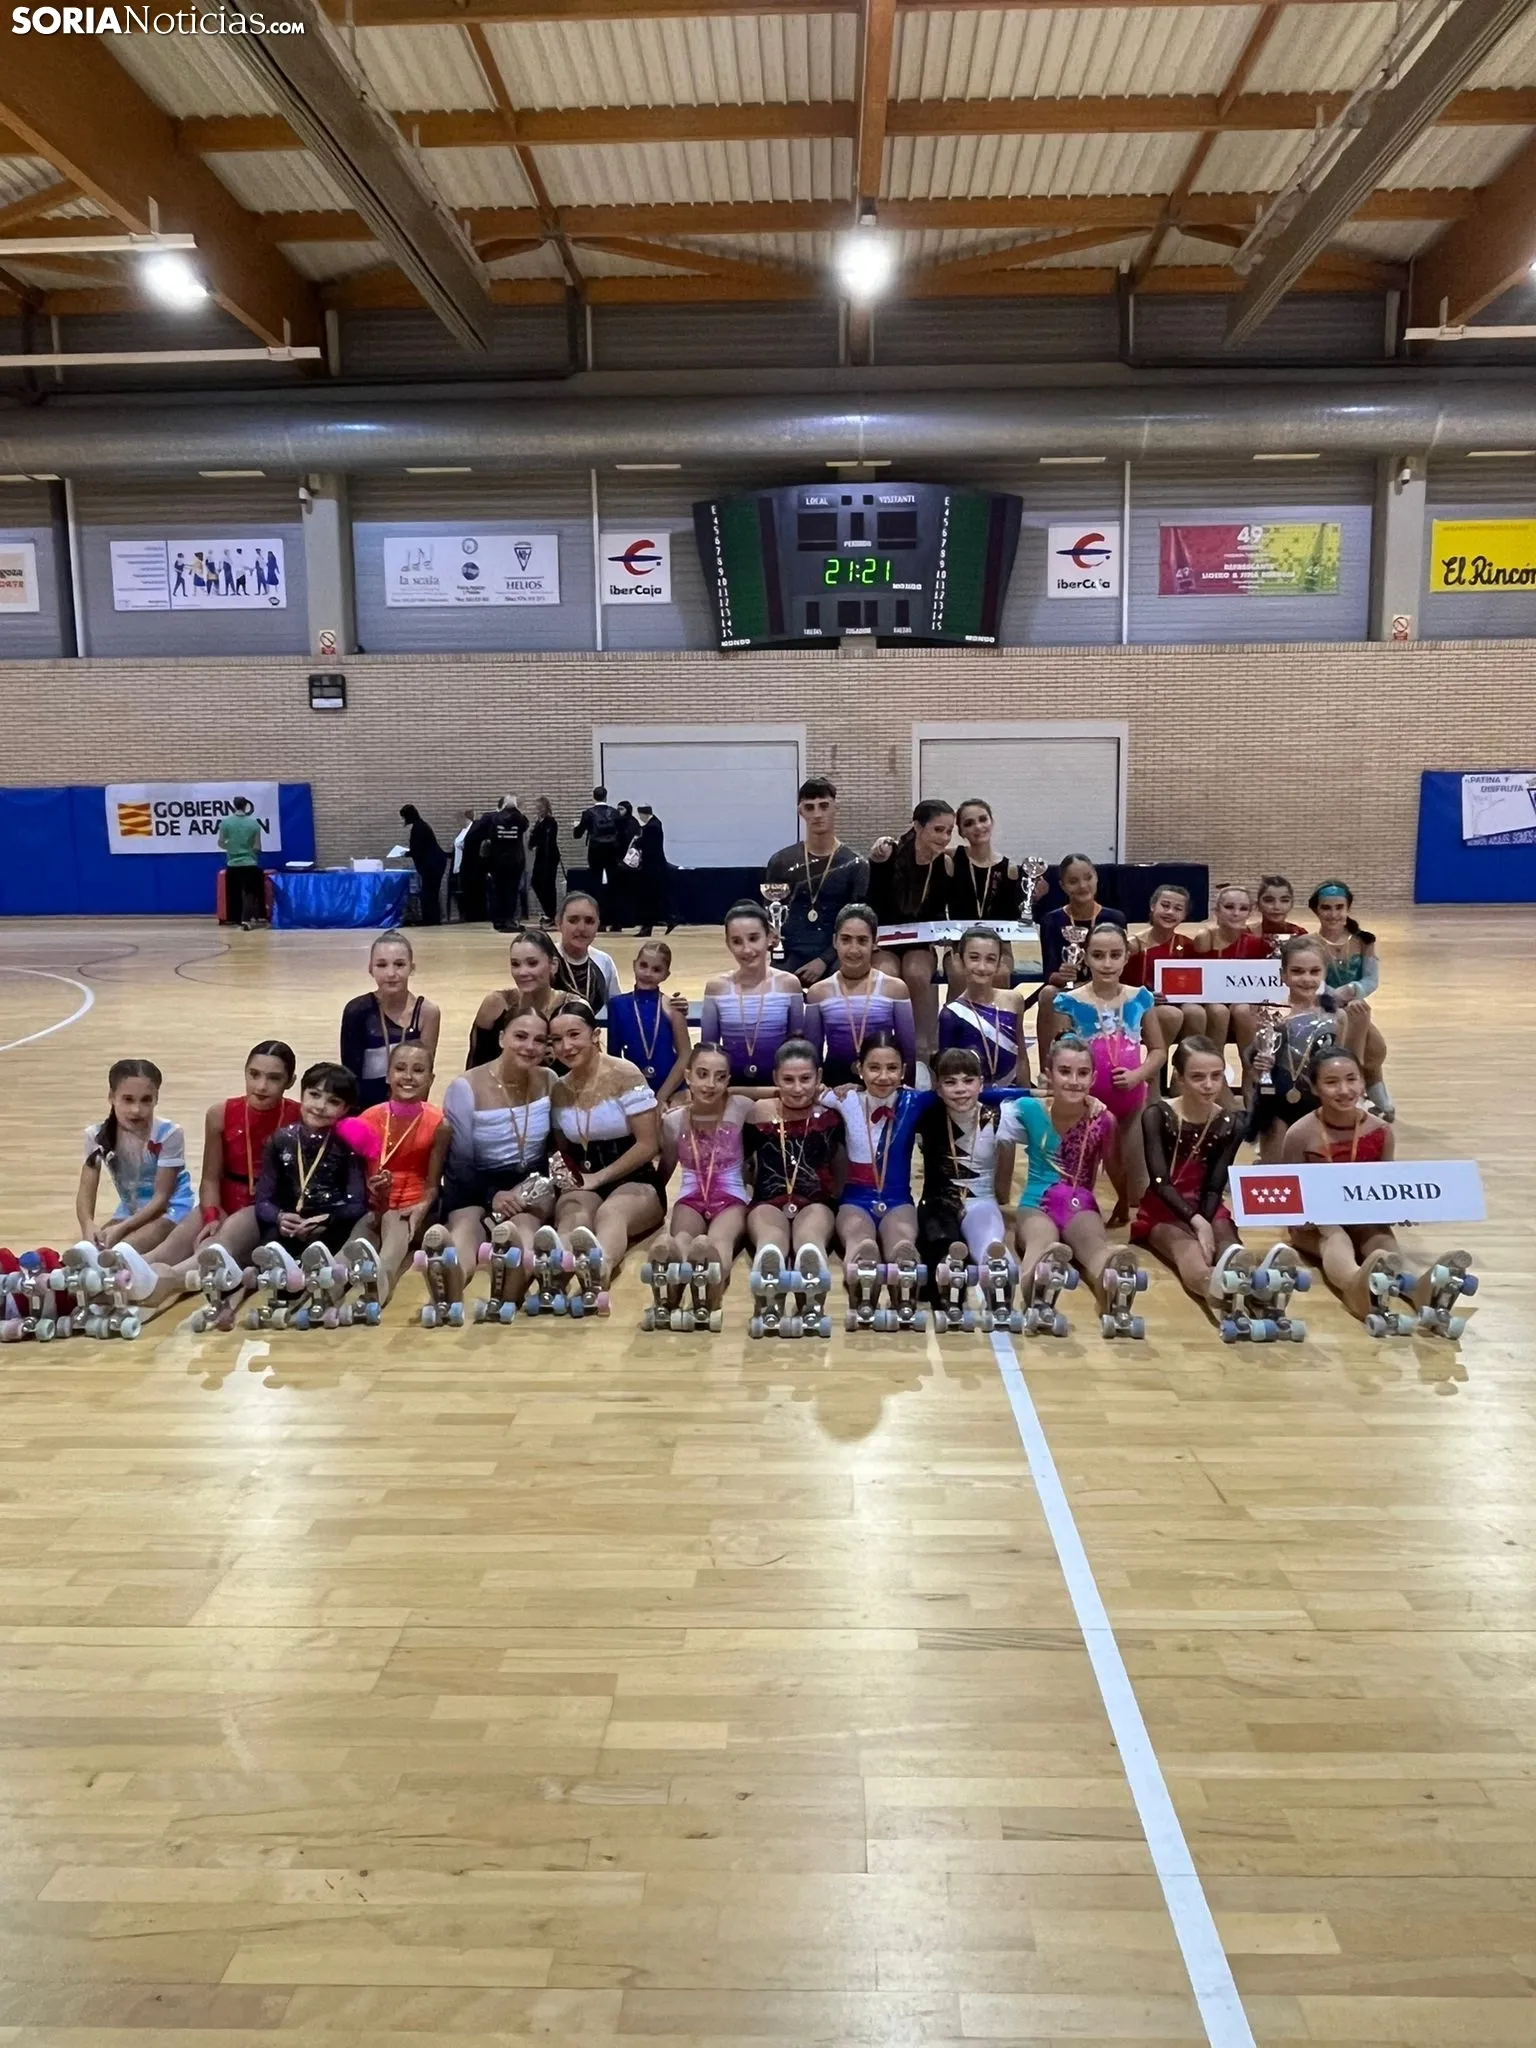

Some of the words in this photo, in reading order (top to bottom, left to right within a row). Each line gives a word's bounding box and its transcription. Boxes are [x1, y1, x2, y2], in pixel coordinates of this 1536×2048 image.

[1236, 526, 1264, 543] 49
[825, 558, 890, 584] 21:21
[1441, 556, 1466, 586] El
[1468, 555, 1536, 586] Rincón
[506, 581, 542, 590] HELIOS
[610, 585, 662, 597] iberCaja
[155, 820, 181, 836] DE
[1343, 1183, 1441, 1201] MADRID
